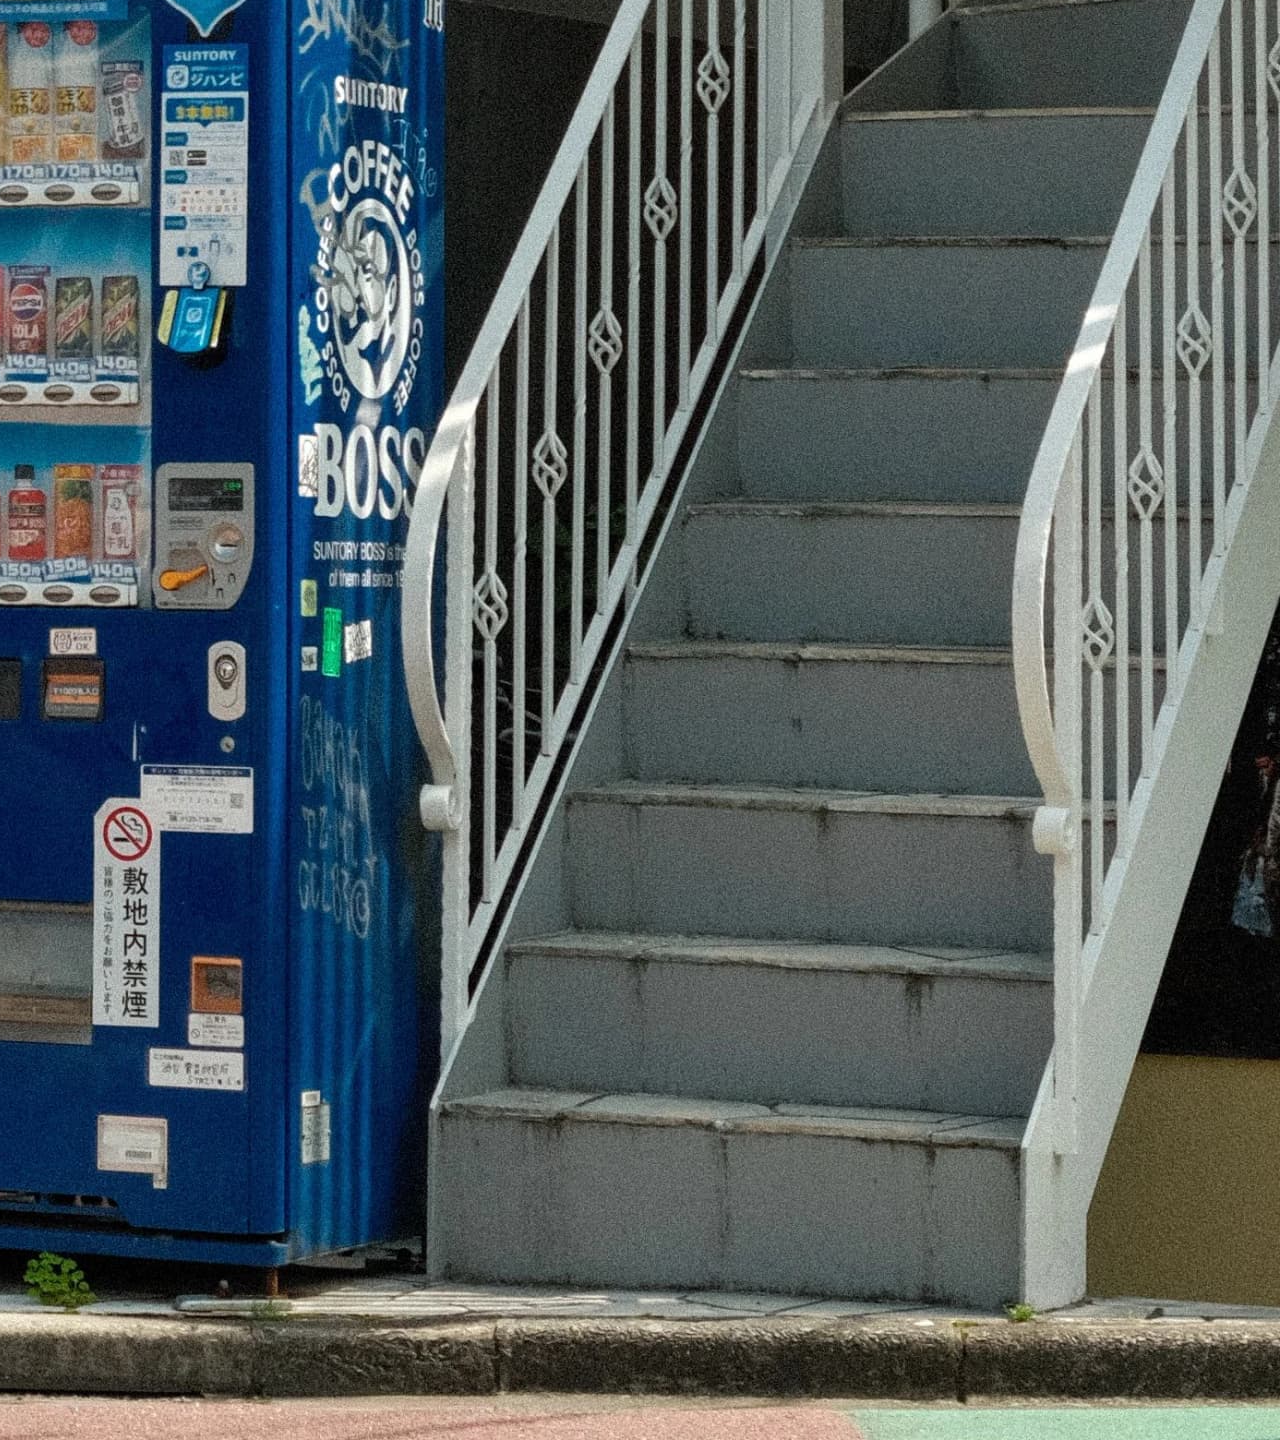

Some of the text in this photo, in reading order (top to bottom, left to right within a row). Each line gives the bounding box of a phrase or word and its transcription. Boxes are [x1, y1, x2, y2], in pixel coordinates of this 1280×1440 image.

[174, 49, 237, 62] SUNTORY
[334, 75, 408, 114] SUNTORY
[328, 140, 414, 225] COFFEE
[393, 228, 425, 416] BOSS COFFEE
[321, 340, 351, 414] BOSS
[313, 422, 425, 520] BOSS
[313, 540, 359, 561] SUNTORY
[360, 541, 386, 561] BOSS
[329, 569, 338, 587] of
[339, 569, 360, 588] them
[361, 569, 372, 588] all
[372, 569, 394, 588] since
[122, 867, 148, 1019] 敷地内禁煙
